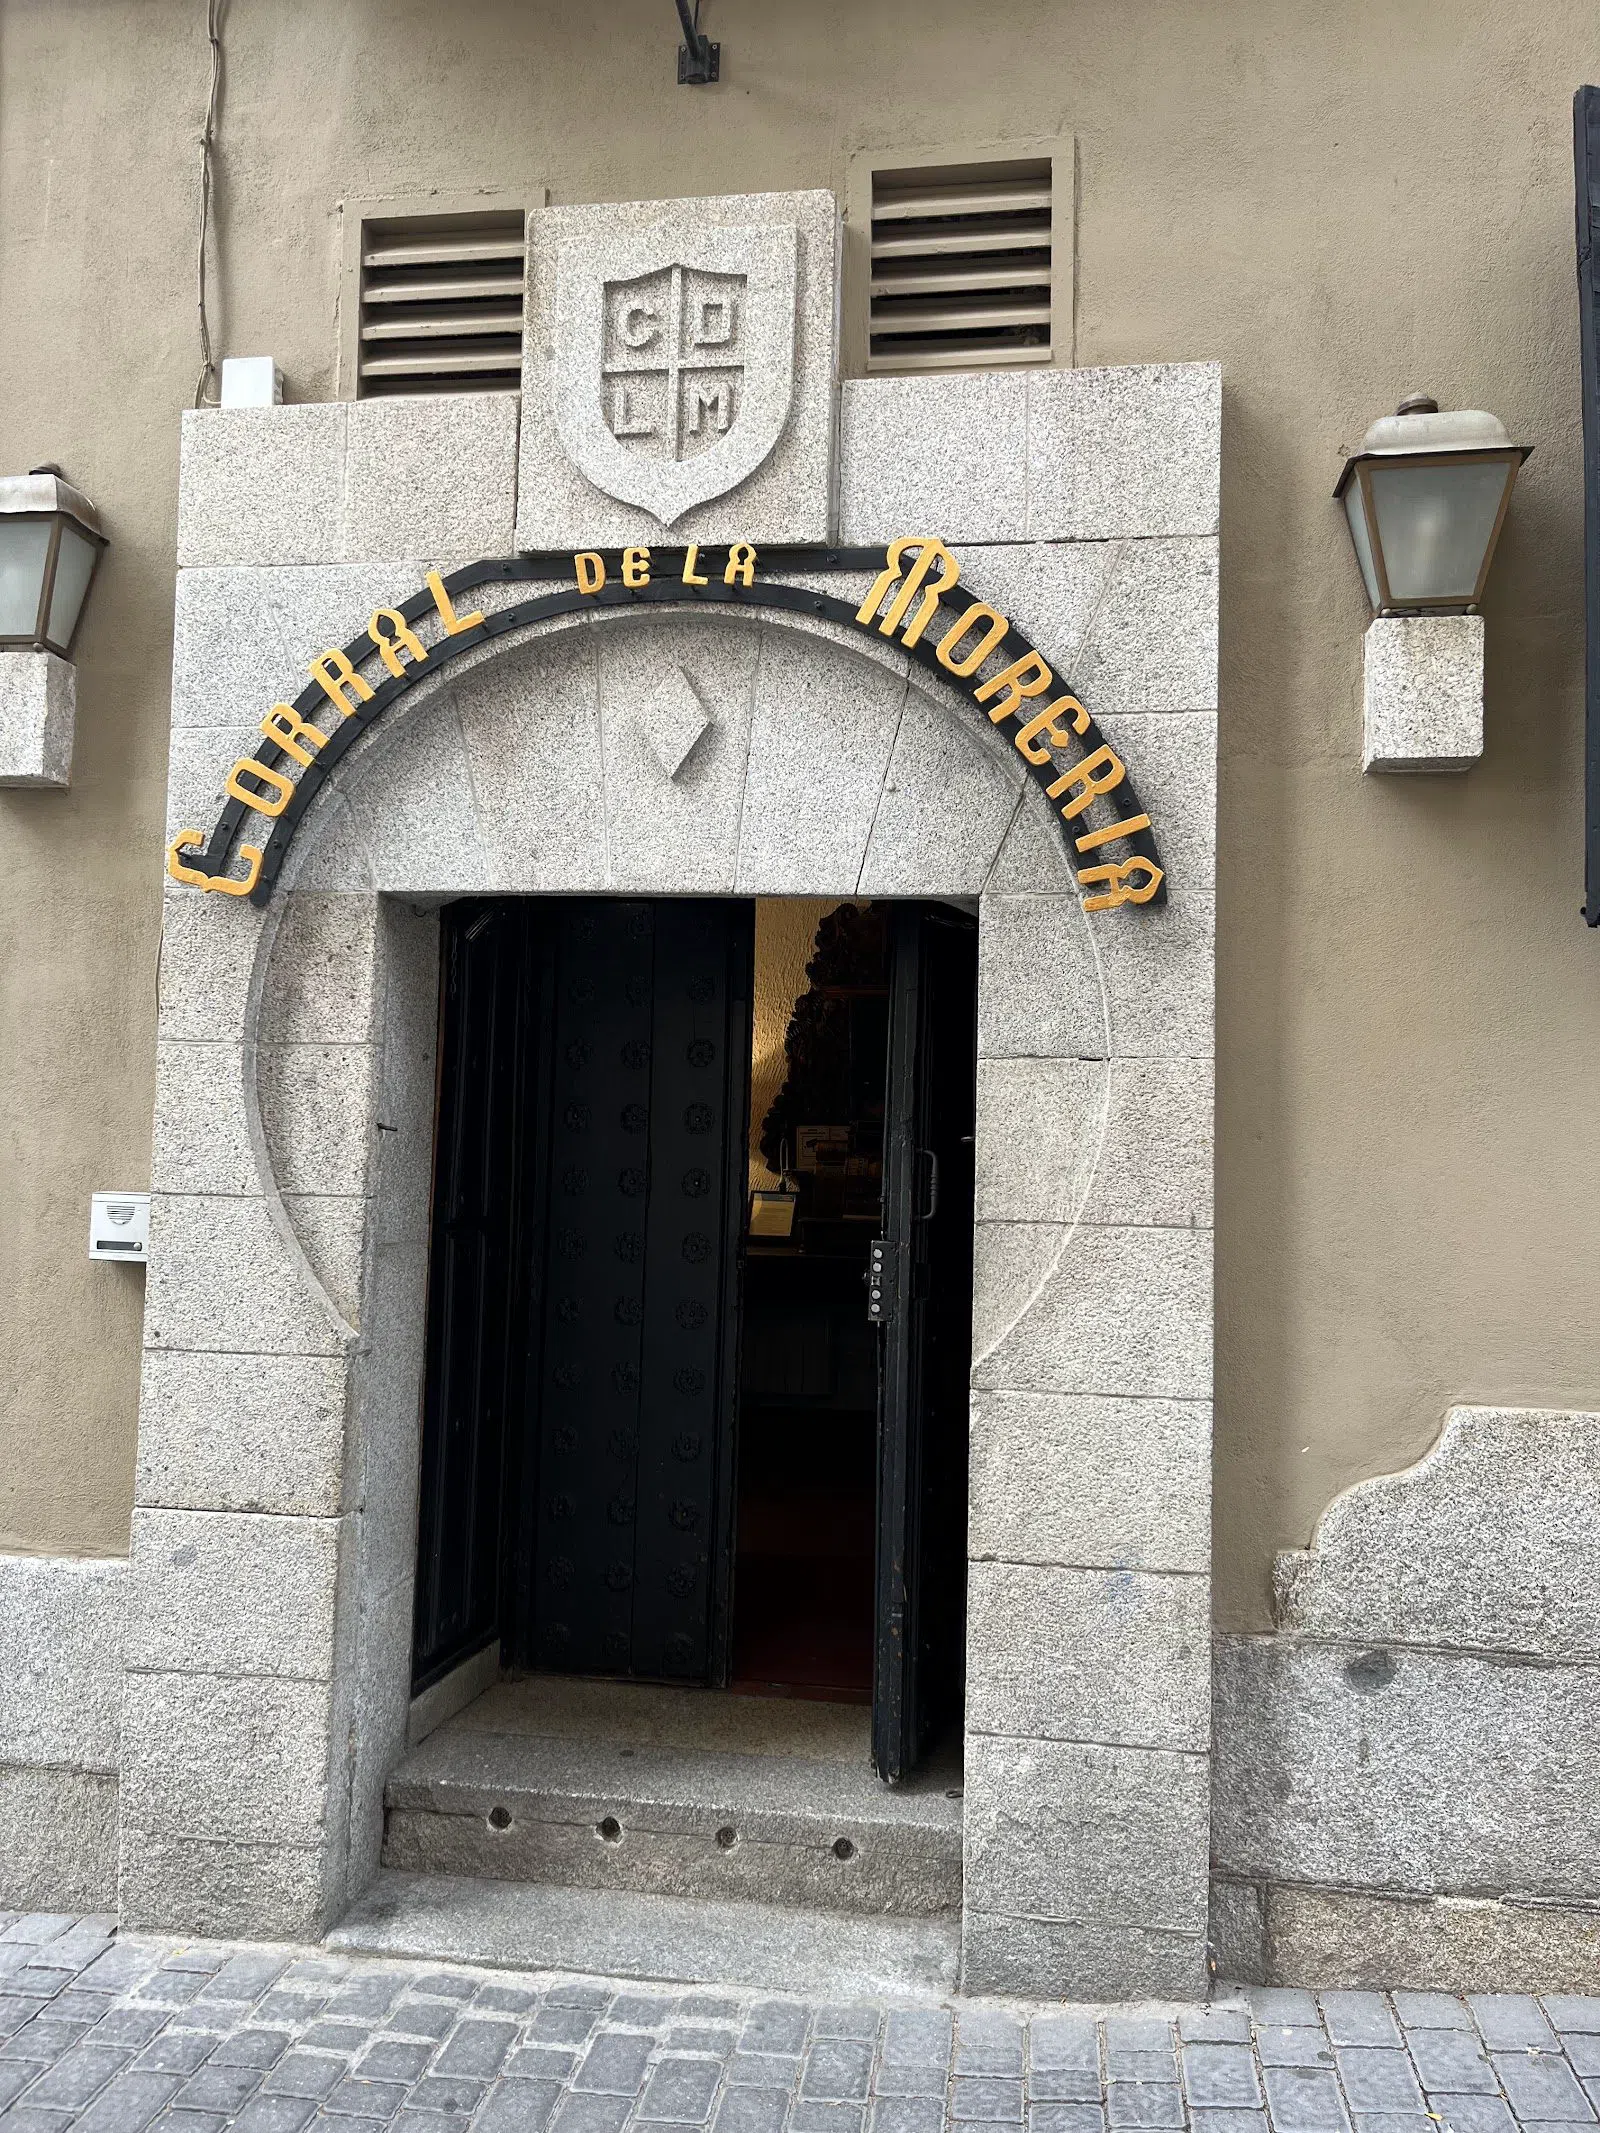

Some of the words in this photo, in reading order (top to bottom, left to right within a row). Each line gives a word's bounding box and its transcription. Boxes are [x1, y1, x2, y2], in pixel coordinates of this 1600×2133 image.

[619, 302, 659, 347] C
[692, 300, 731, 346] D
[613, 386, 653, 435] L
[689, 381, 732, 436] M
[167, 570, 485, 895] CORRAL
[574, 546, 651, 594] DE
[682, 542, 757, 588] LA
[855, 537, 1164, 912] MORERIA
